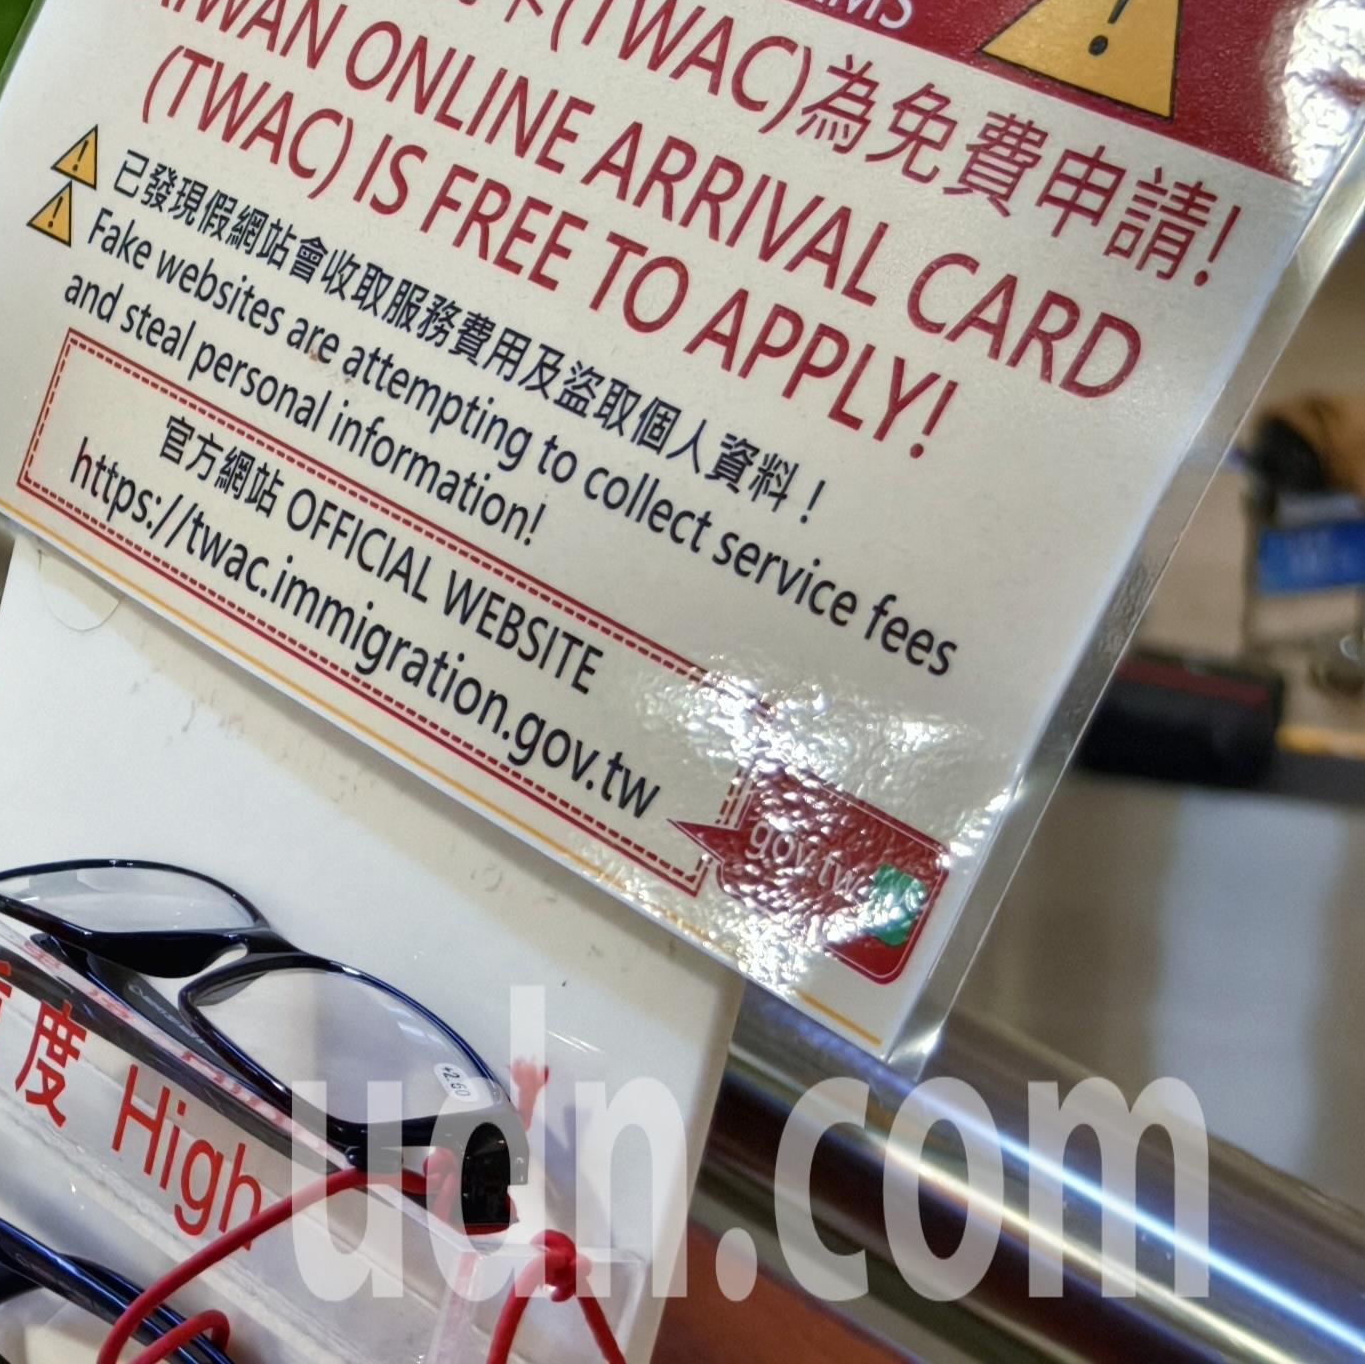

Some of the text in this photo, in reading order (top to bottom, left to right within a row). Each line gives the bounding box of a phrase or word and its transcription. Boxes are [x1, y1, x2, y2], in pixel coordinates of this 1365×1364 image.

[141, 44, 959, 460] (TWAC) IS FREE TO APPLY!
[344, 19, 596, 175] ONLINE
[580, 119, 890, 307] ARRIVAL
[907, 252, 1143, 399] CARD
[63, 272, 548, 547] and steal personal information!
[87, 206, 960, 679] Fake websites are attempting to collect service fees
[157, 414, 606, 696] 官方網站 OFFICIAL WEBSITE
[69, 436, 662, 820] https://twac.immigration.gov.tw
[111, 1064, 268, 1252] High
